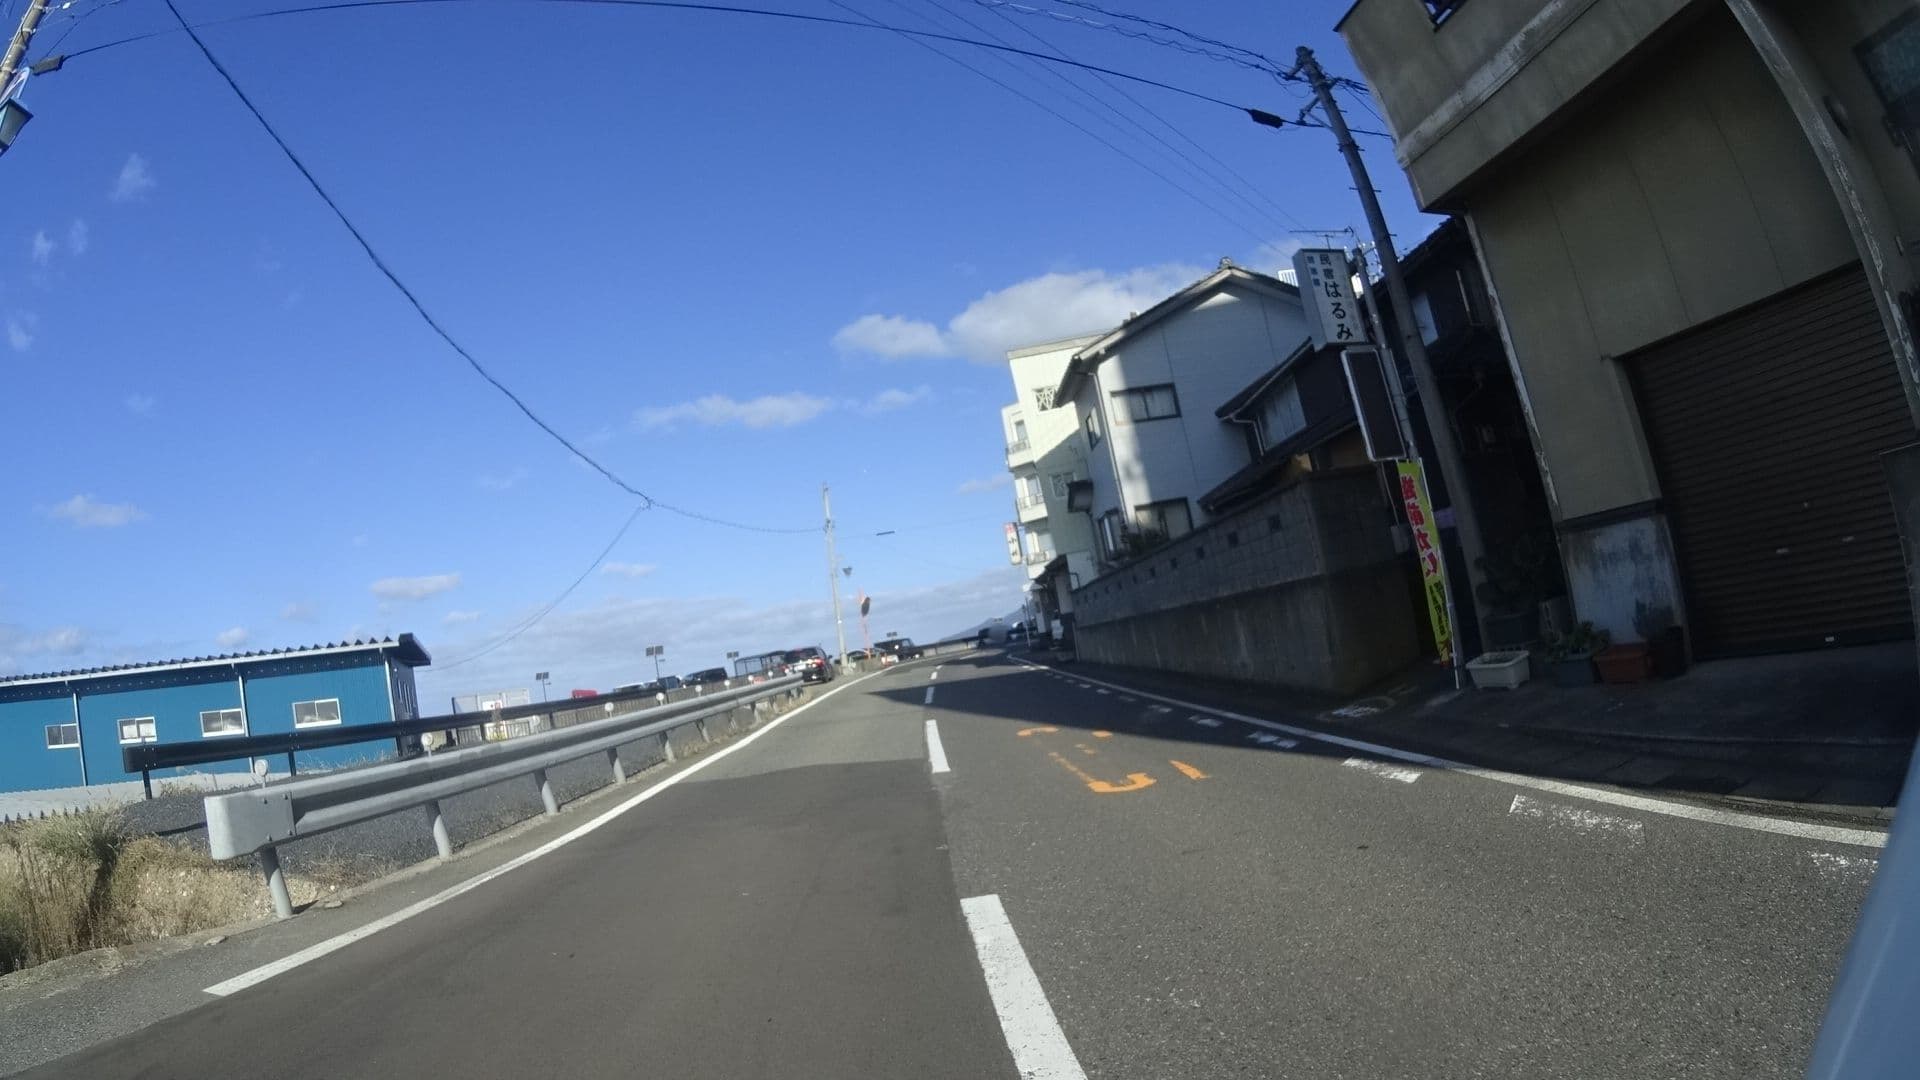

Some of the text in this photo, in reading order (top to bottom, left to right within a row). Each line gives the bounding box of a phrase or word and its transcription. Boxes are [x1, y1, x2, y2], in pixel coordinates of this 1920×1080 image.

[1319, 254, 1353, 340] 民宿はるみ
